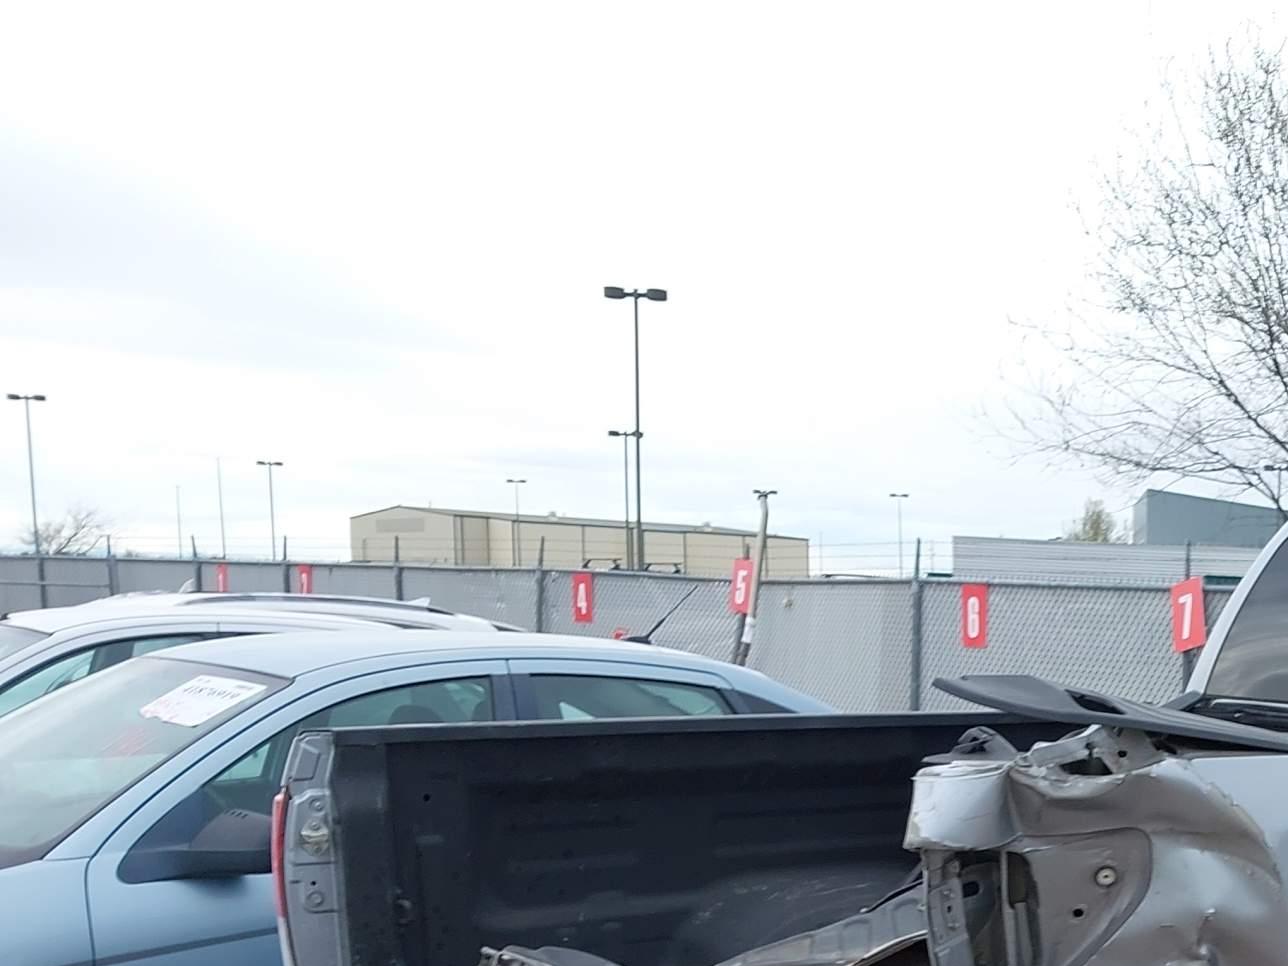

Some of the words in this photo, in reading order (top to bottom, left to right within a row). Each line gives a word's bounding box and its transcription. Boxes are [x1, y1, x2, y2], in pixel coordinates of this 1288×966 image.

[576, 582, 588, 616] 4
[734, 569, 748, 605] 5
[966, 596, 980, 639] 6
[1177, 592, 1193, 640] 7
